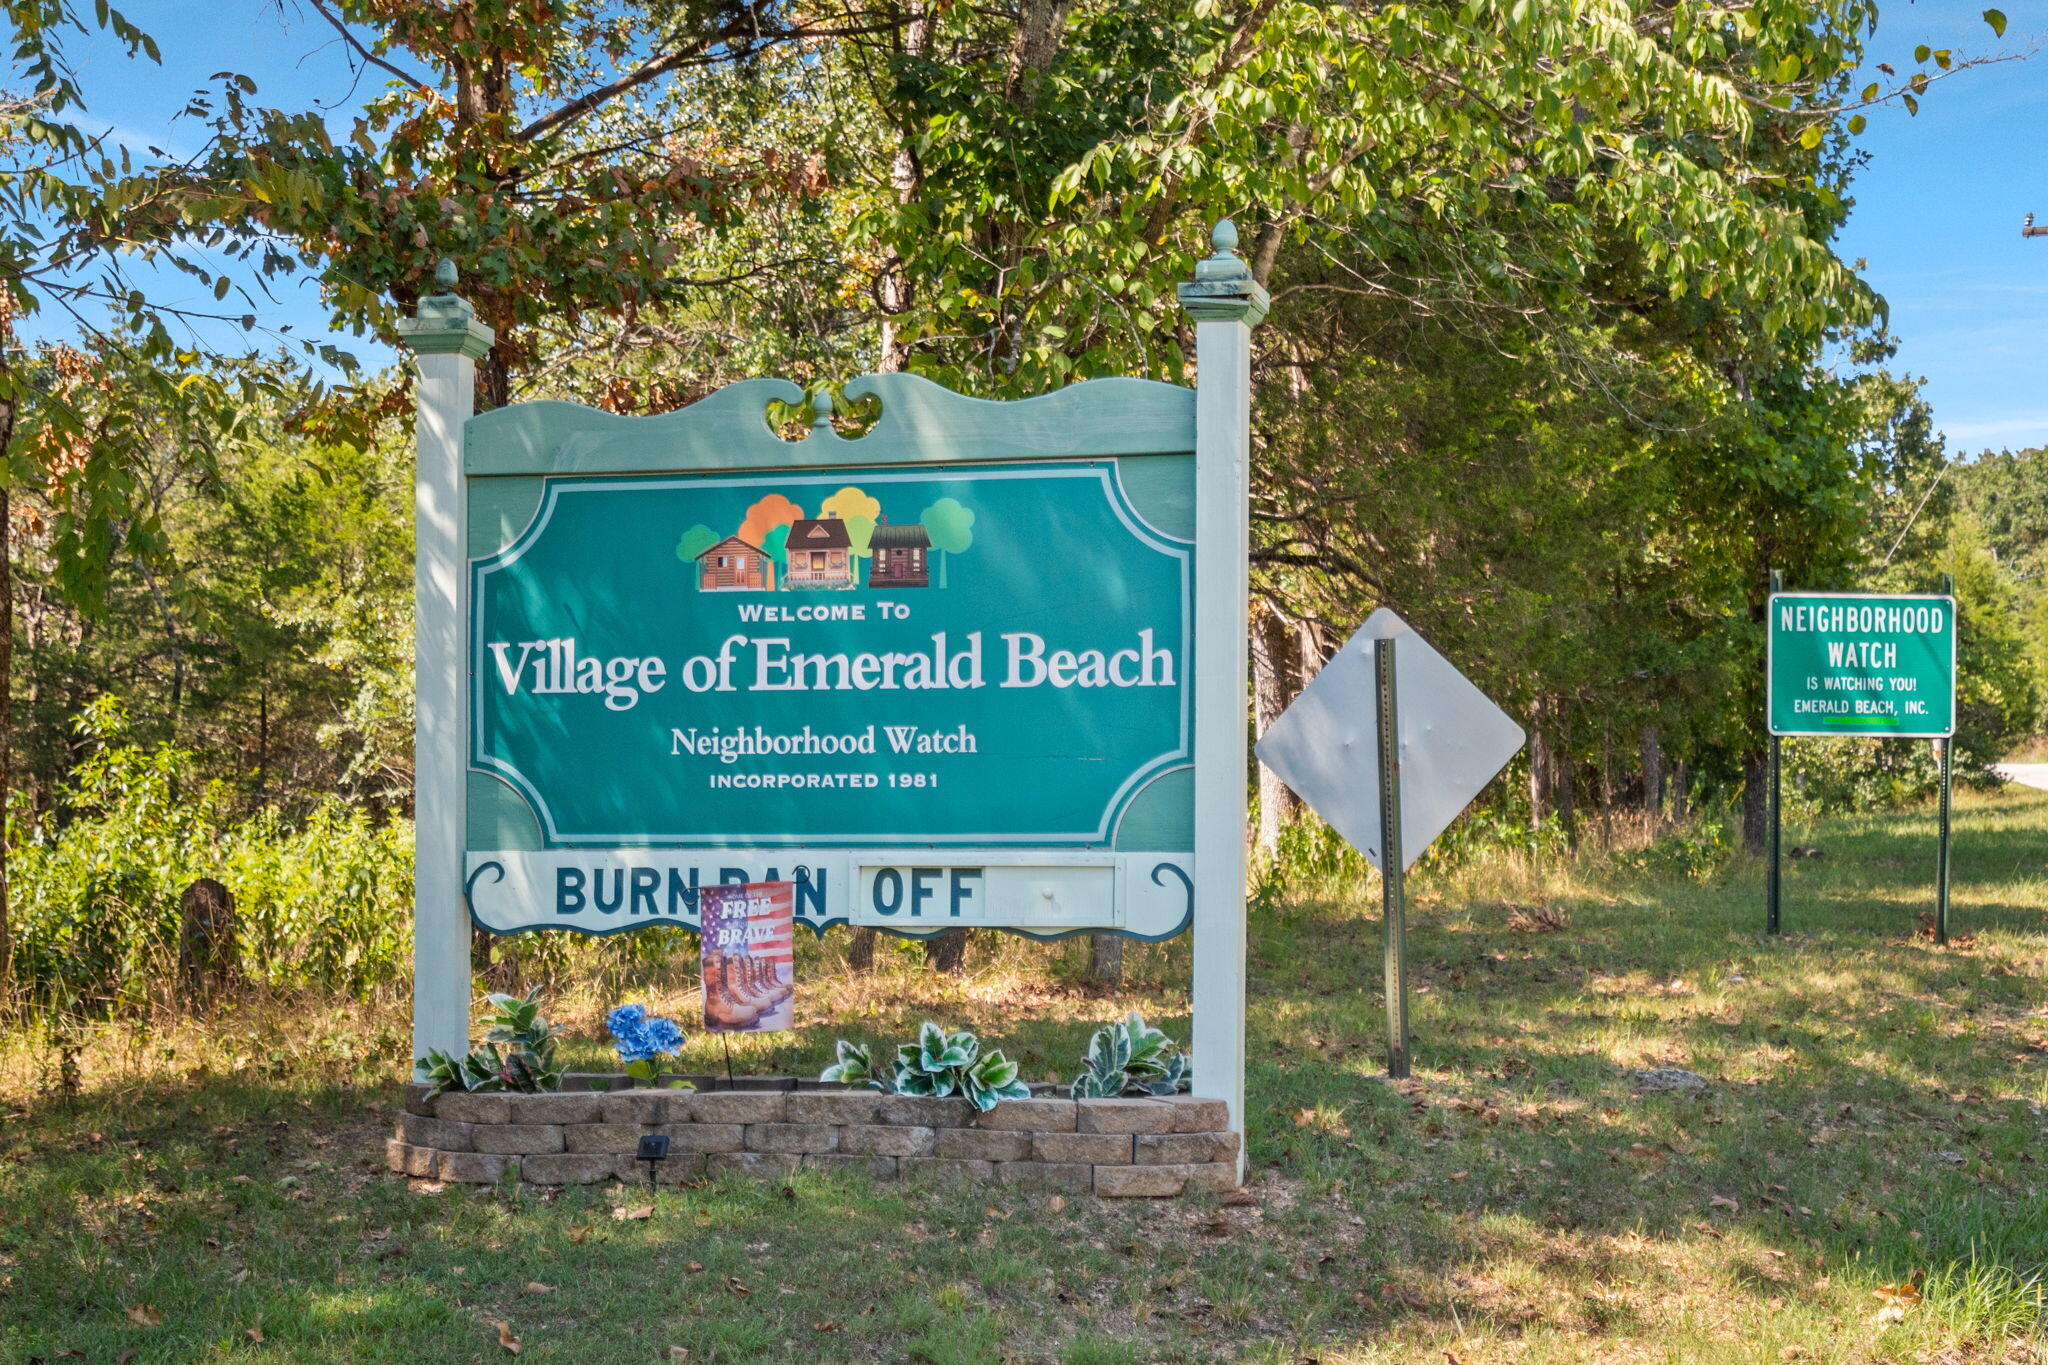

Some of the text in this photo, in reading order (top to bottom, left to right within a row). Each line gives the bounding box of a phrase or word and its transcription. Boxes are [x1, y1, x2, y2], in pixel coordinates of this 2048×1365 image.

[1781, 605, 1944, 634] NEIGHBORHOOD
[1827, 641, 1897, 669] WATCH
[487, 627, 1177, 712] Village of Emerald Beach
[1806, 676, 1917, 692] IS WATCHING YOU!
[1794, 699, 1929, 717] EMERALD BEACH, INC.
[670, 723, 978, 764] Neighborhood Watch
[709, 773, 938, 789] INCORPORATED 1981
[556, 867, 700, 916] BURN
[872, 867, 983, 917] OFF
[720, 898, 772, 919] FREE
[718, 927, 776, 946] BRAVE
